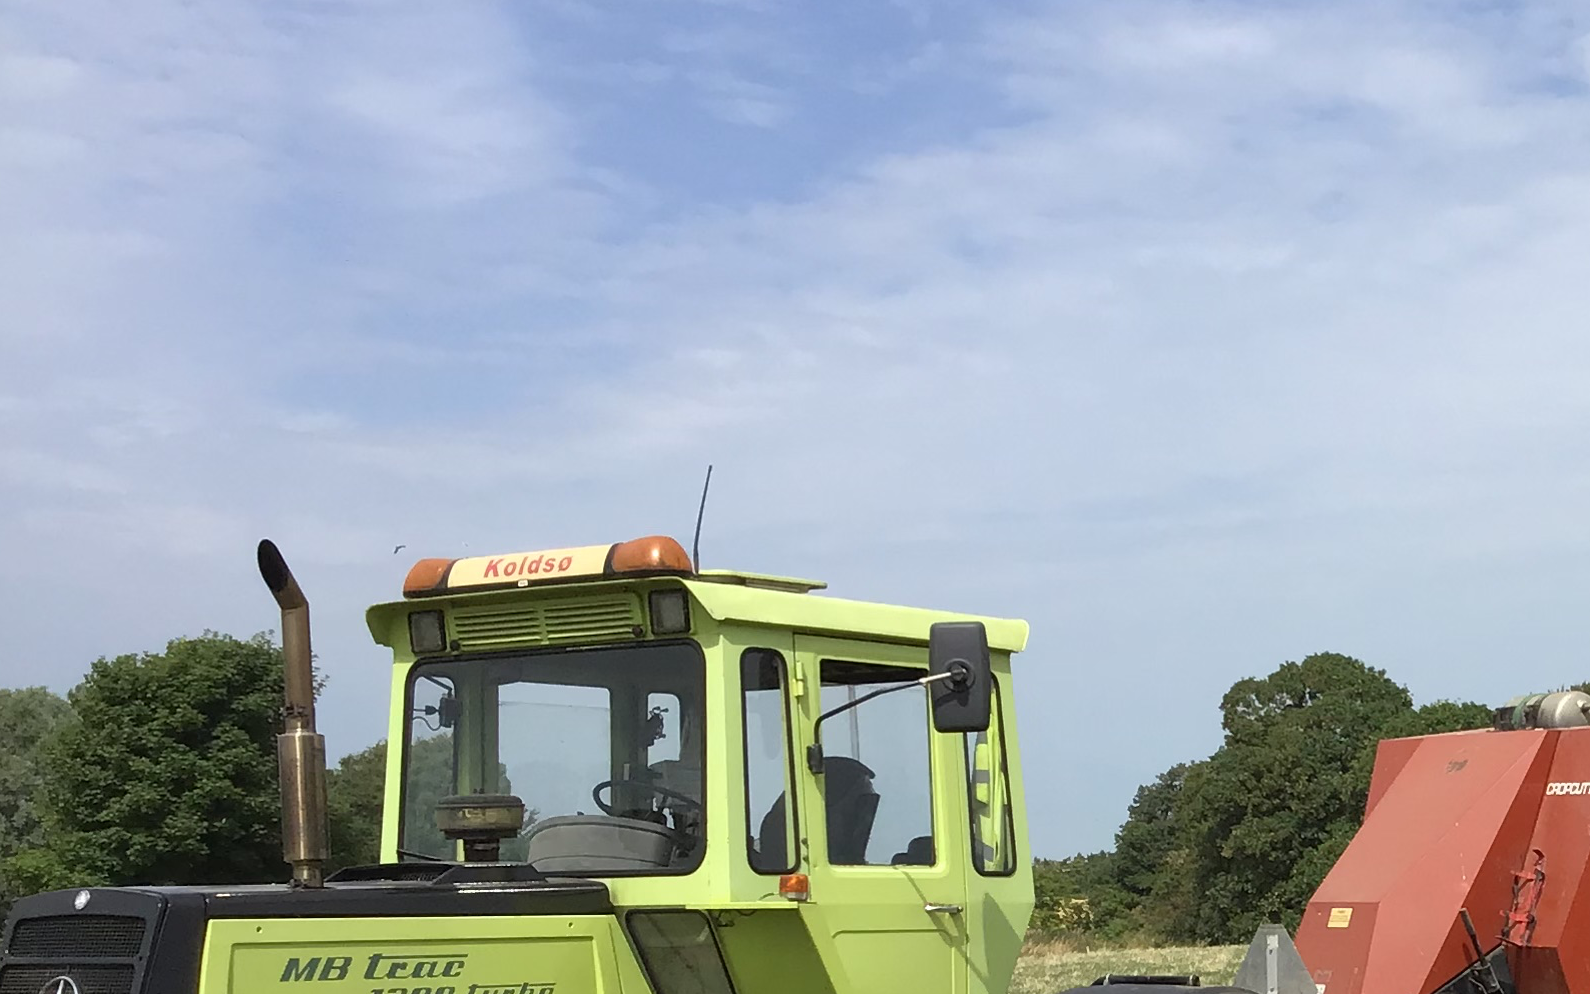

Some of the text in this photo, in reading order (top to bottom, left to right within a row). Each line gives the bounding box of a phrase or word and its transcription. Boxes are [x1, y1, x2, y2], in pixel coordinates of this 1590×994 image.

[483, 554, 574, 579] Koldsø
[279, 952, 469, 983] MB trac
